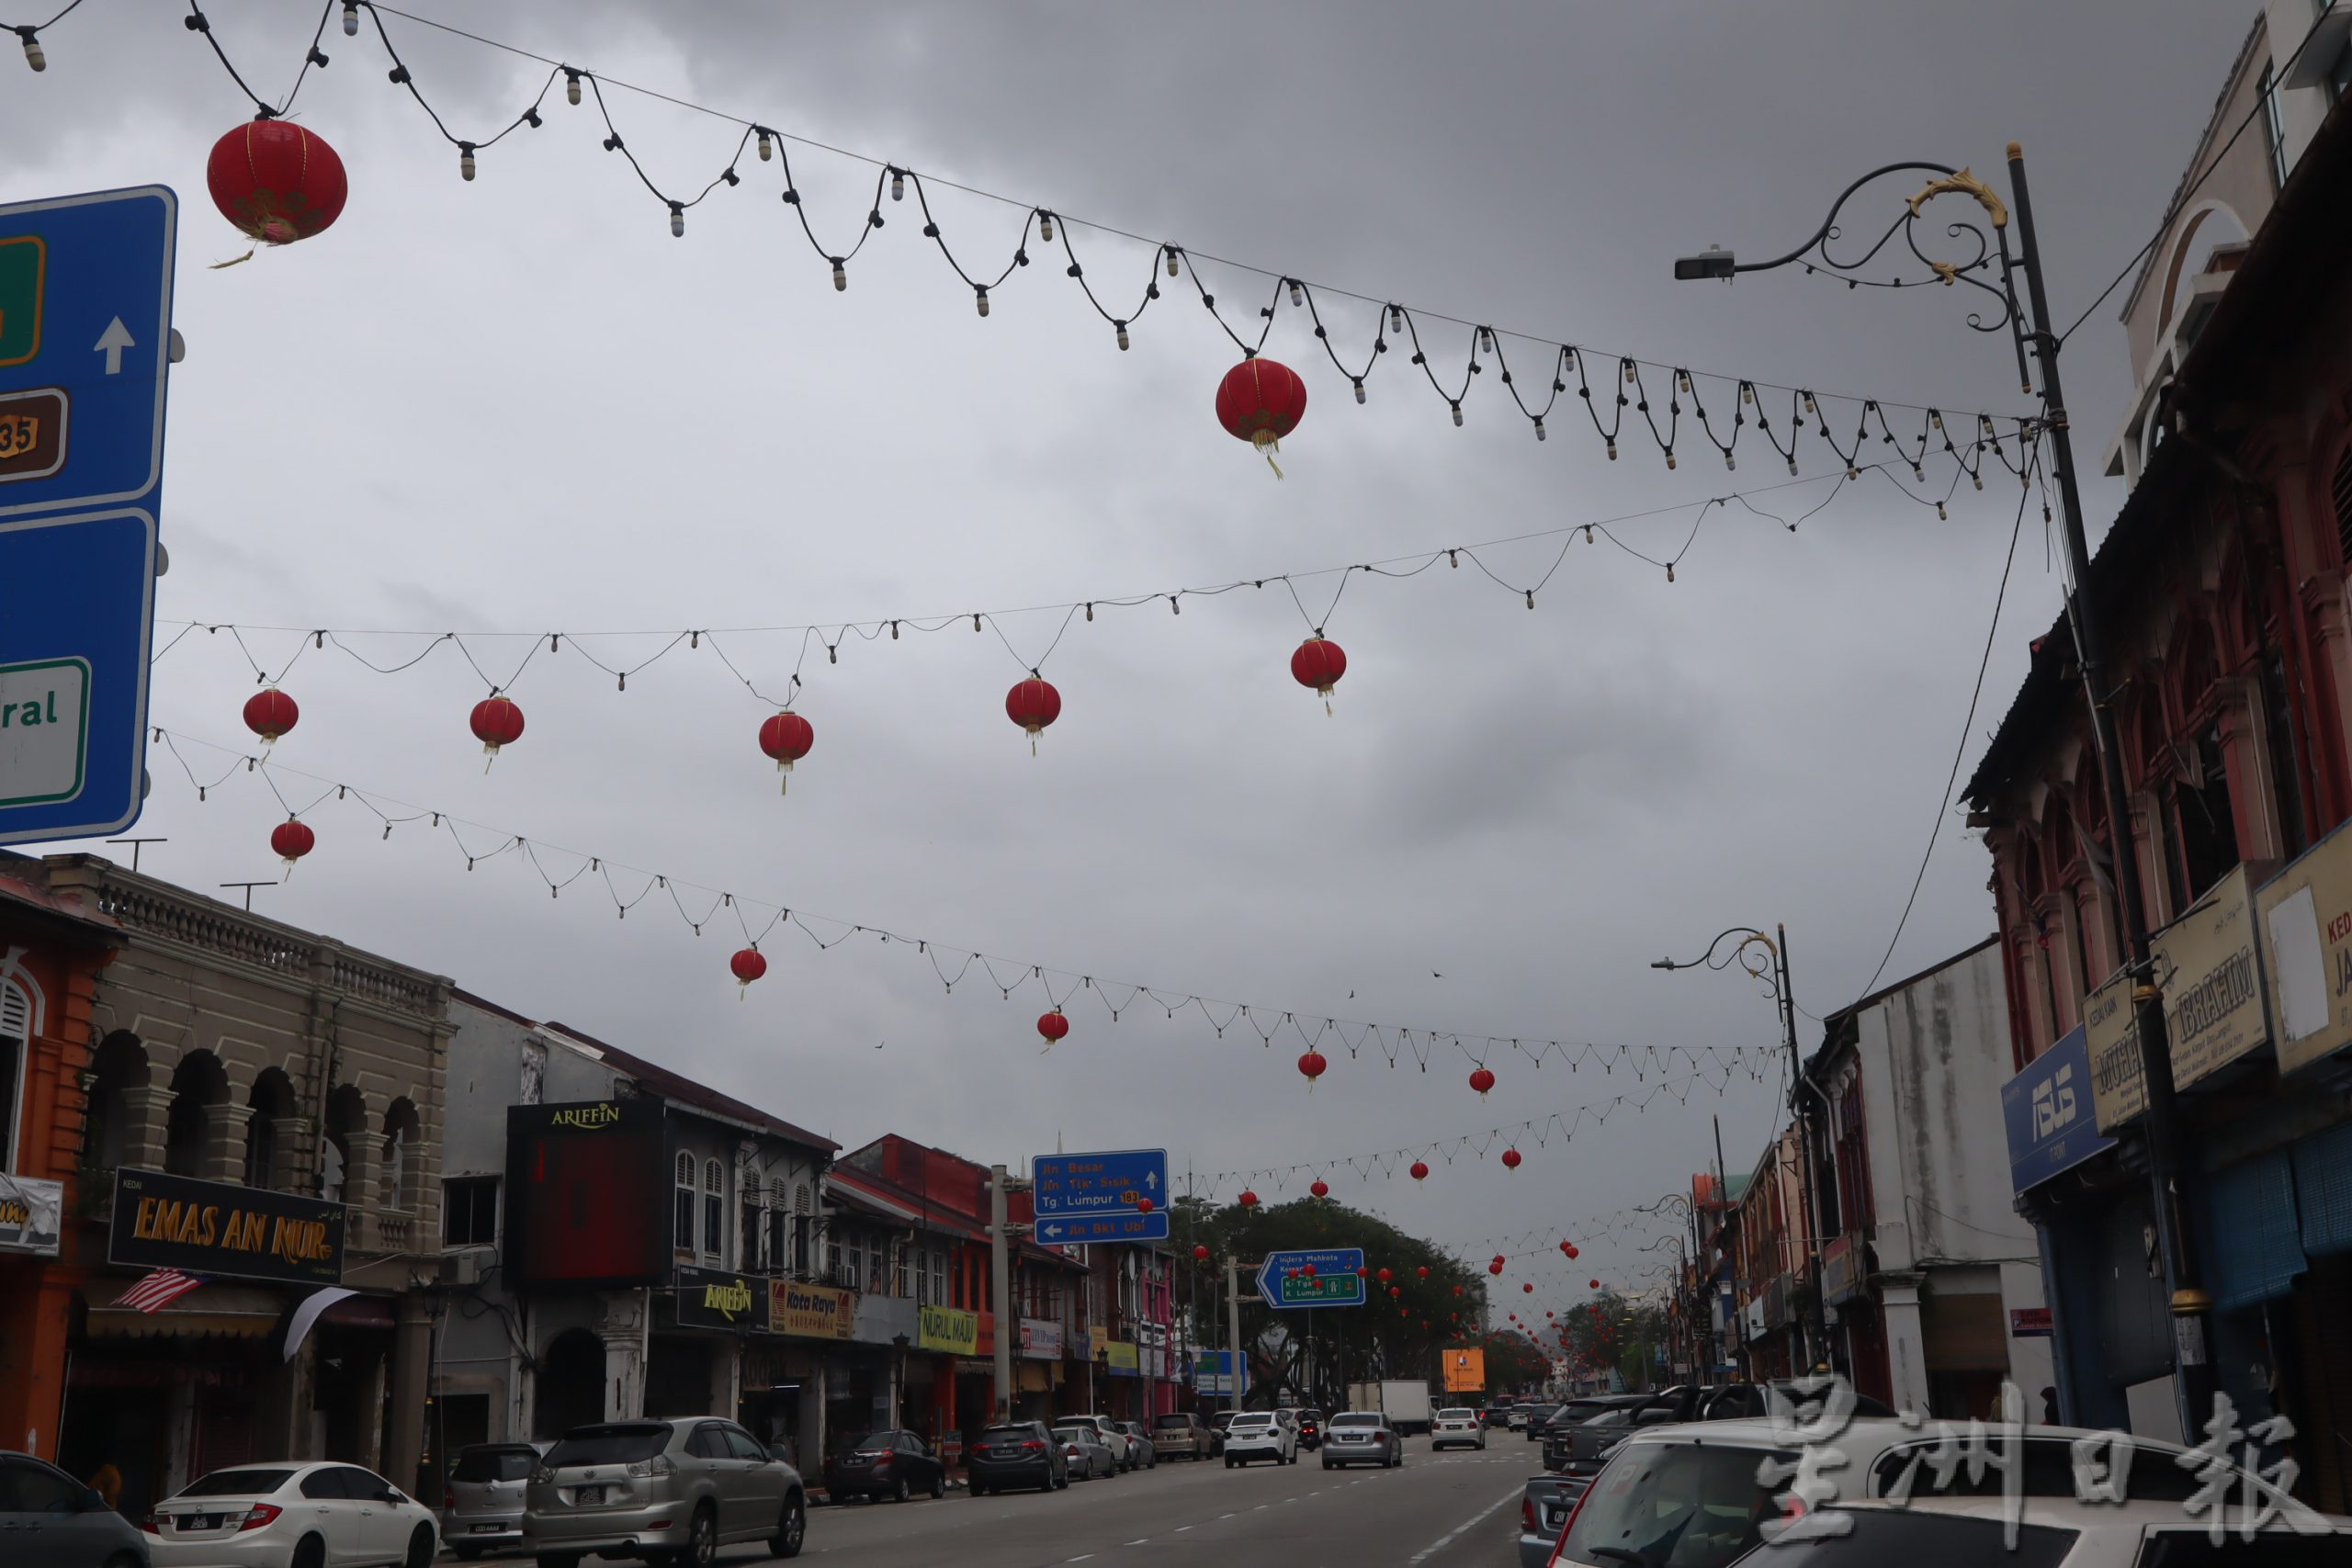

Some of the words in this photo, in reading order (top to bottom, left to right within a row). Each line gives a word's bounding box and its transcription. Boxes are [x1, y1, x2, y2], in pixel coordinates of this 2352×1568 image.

[0, 421, 30, 451] 35
[2, 691, 57, 728] ral
[2176, 944, 2256, 1044] IBRAHIM
[2032, 1063, 2075, 1143] ASUS
[1042, 1164, 1058, 1175] Jln
[1068, 1162, 1103, 1173] Besar
[122, 1179, 142, 1190] KEDAI
[1042, 1179, 1059, 1191] Jln
[1067, 1194, 1114, 1207] Lumpur
[1123, 1192, 1137, 1202] 183
[132, 1196, 219, 1247] EMAS
[220, 1208, 268, 1254] AN
[270, 1215, 333, 1264] NUR
[1069, 1224, 1085, 1235] Jln
[1092, 1223, 1115, 1234] Bkt
[1125, 1220, 1147, 1232] Ubi
[787, 1292, 810, 1311] Kota
[812, 1294, 836, 1316] Raya
[923, 1312, 951, 1341] NURUL
[952, 1317, 974, 1344] MAJU
